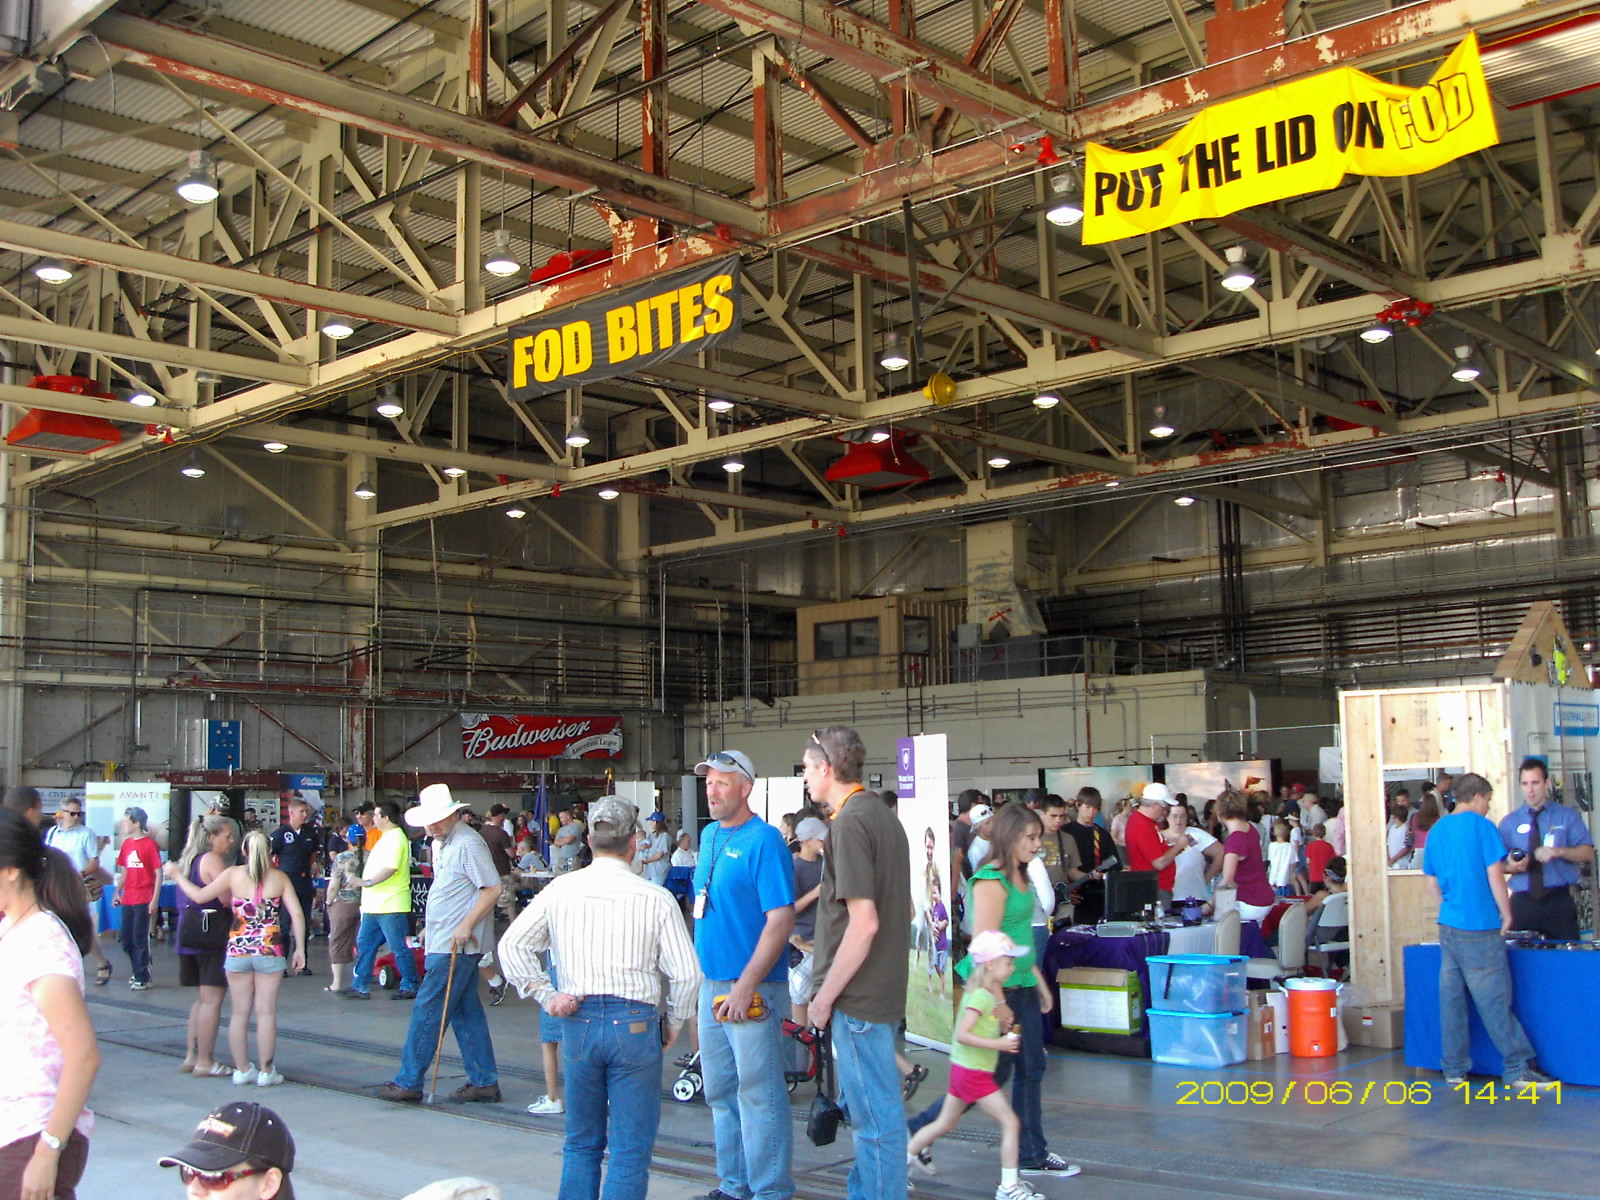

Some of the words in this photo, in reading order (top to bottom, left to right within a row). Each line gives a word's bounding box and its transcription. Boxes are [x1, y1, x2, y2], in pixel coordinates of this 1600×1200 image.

[1094, 164, 1164, 216] PUT
[1179, 134, 1242, 193] THE
[1256, 113, 1316, 173] LID
[1333, 100, 1385, 153] ON
[1387, 72, 1475, 150] FOD
[513, 319, 593, 389] FOD
[606, 274, 734, 364] BITES
[462, 719, 591, 759] Budweiser
[119, 791, 159, 799] AVANTI
